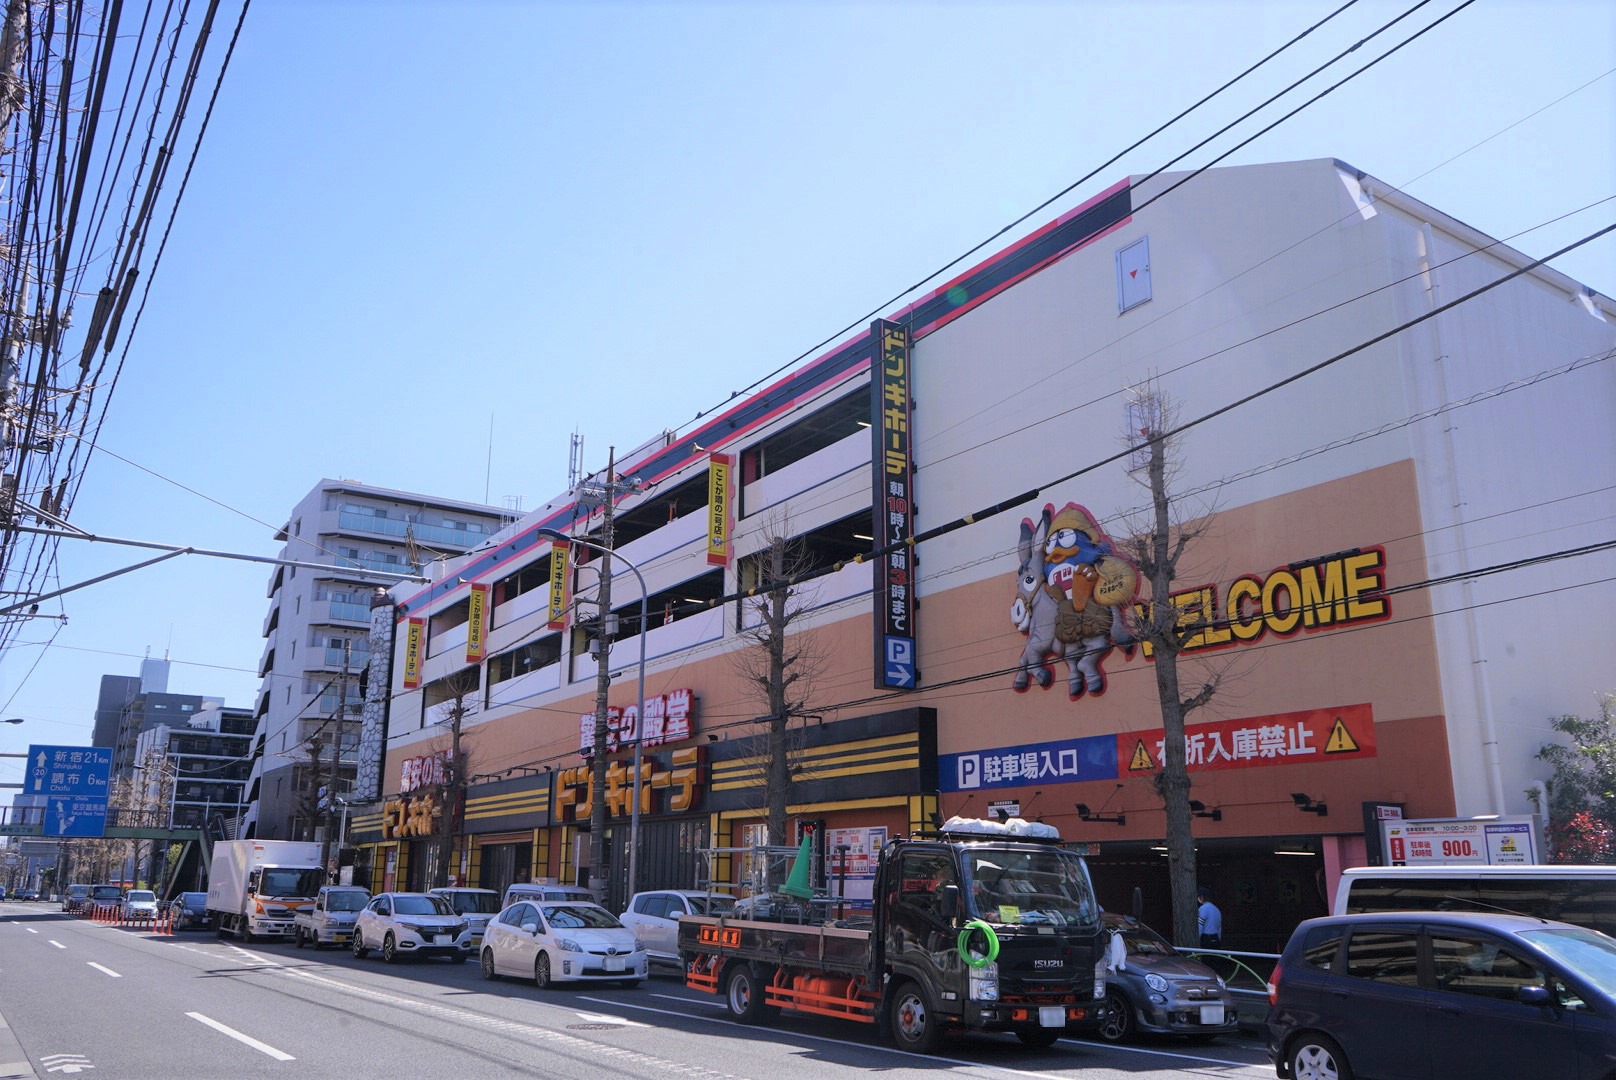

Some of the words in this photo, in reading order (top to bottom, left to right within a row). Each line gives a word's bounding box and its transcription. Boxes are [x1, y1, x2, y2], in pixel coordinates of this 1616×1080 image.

[54, 751, 83, 763] 新宿
[983, 749, 1078, 783] 駐車場入口
[51, 773, 80, 785] 調布
[1410, 841, 1431, 849] 駐車後
[1034, 959, 1065, 968] ISUZU
